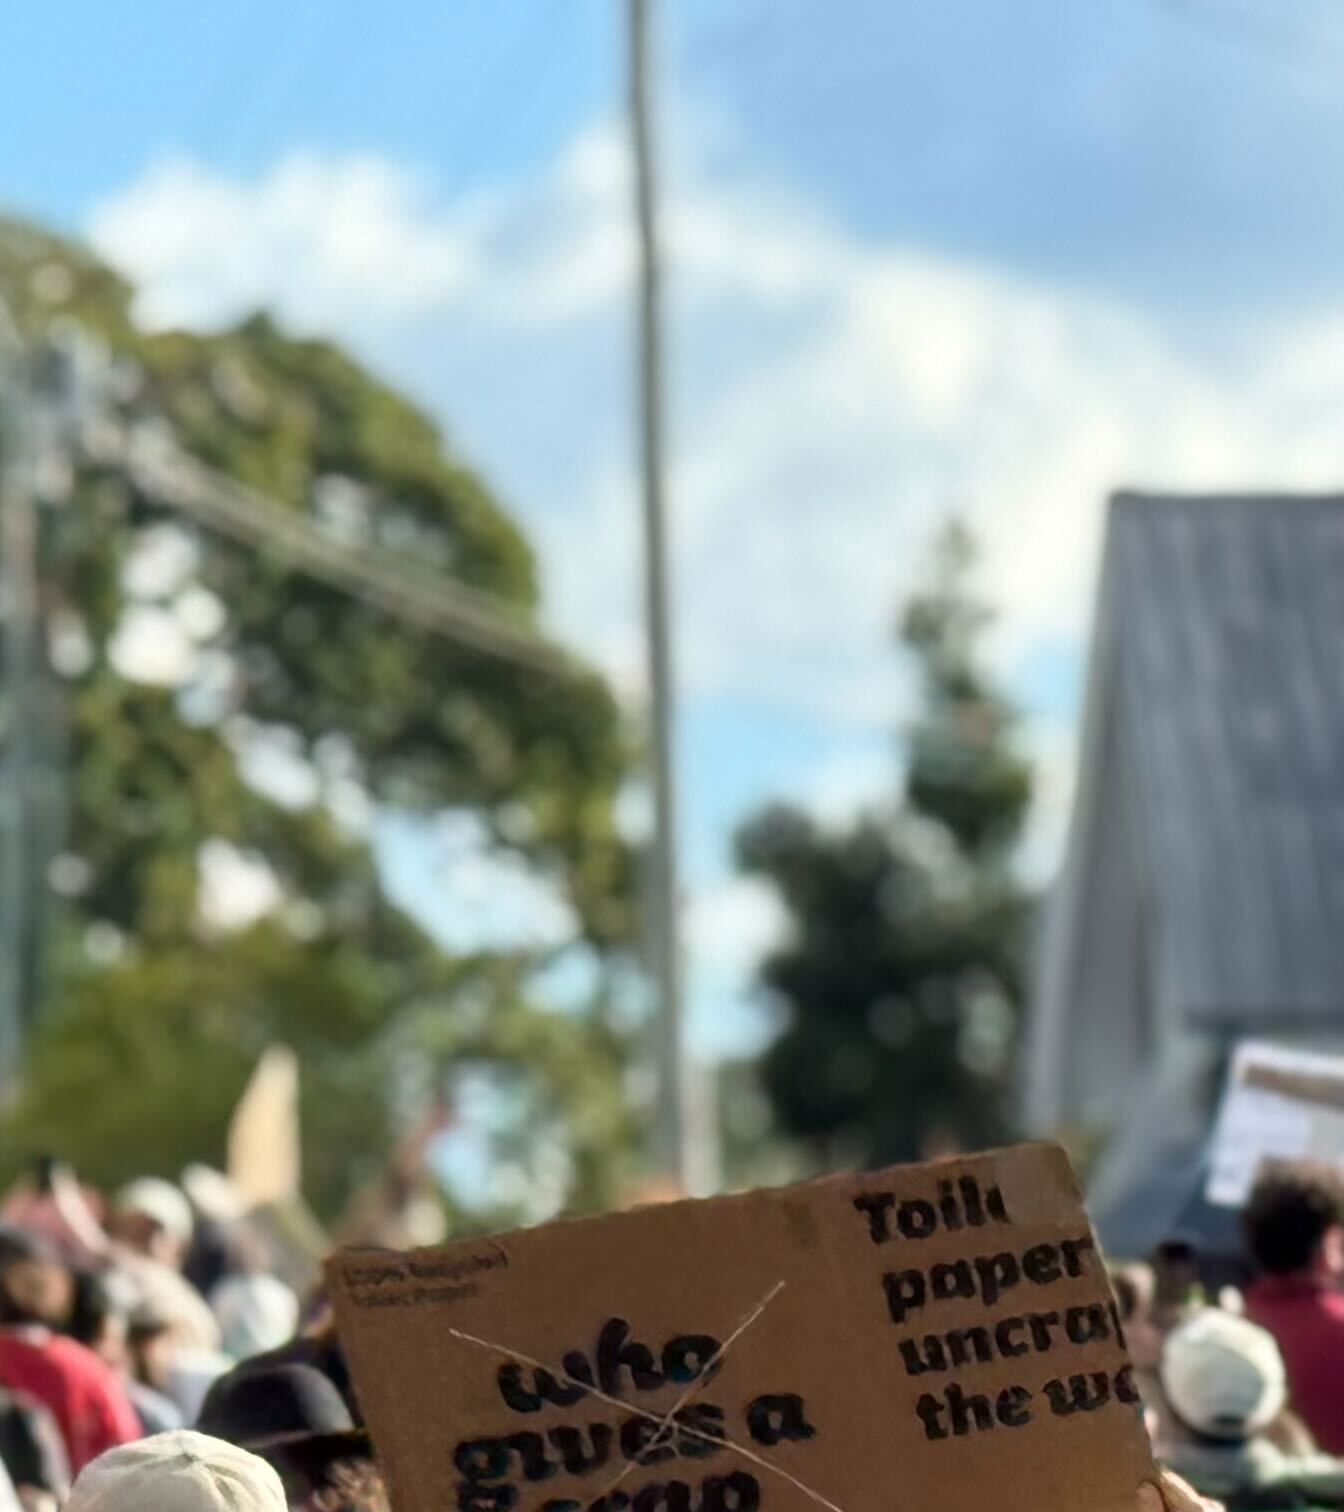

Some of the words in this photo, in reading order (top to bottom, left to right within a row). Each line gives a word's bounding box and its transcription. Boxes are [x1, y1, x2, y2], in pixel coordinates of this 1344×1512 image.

[882, 1236, 1095, 1325] paper
[496, 1317, 725, 1414] who
[896, 1300, 1127, 1376] uncra
[746, 1392, 817, 1447] a
[915, 1381, 1034, 1441] the
